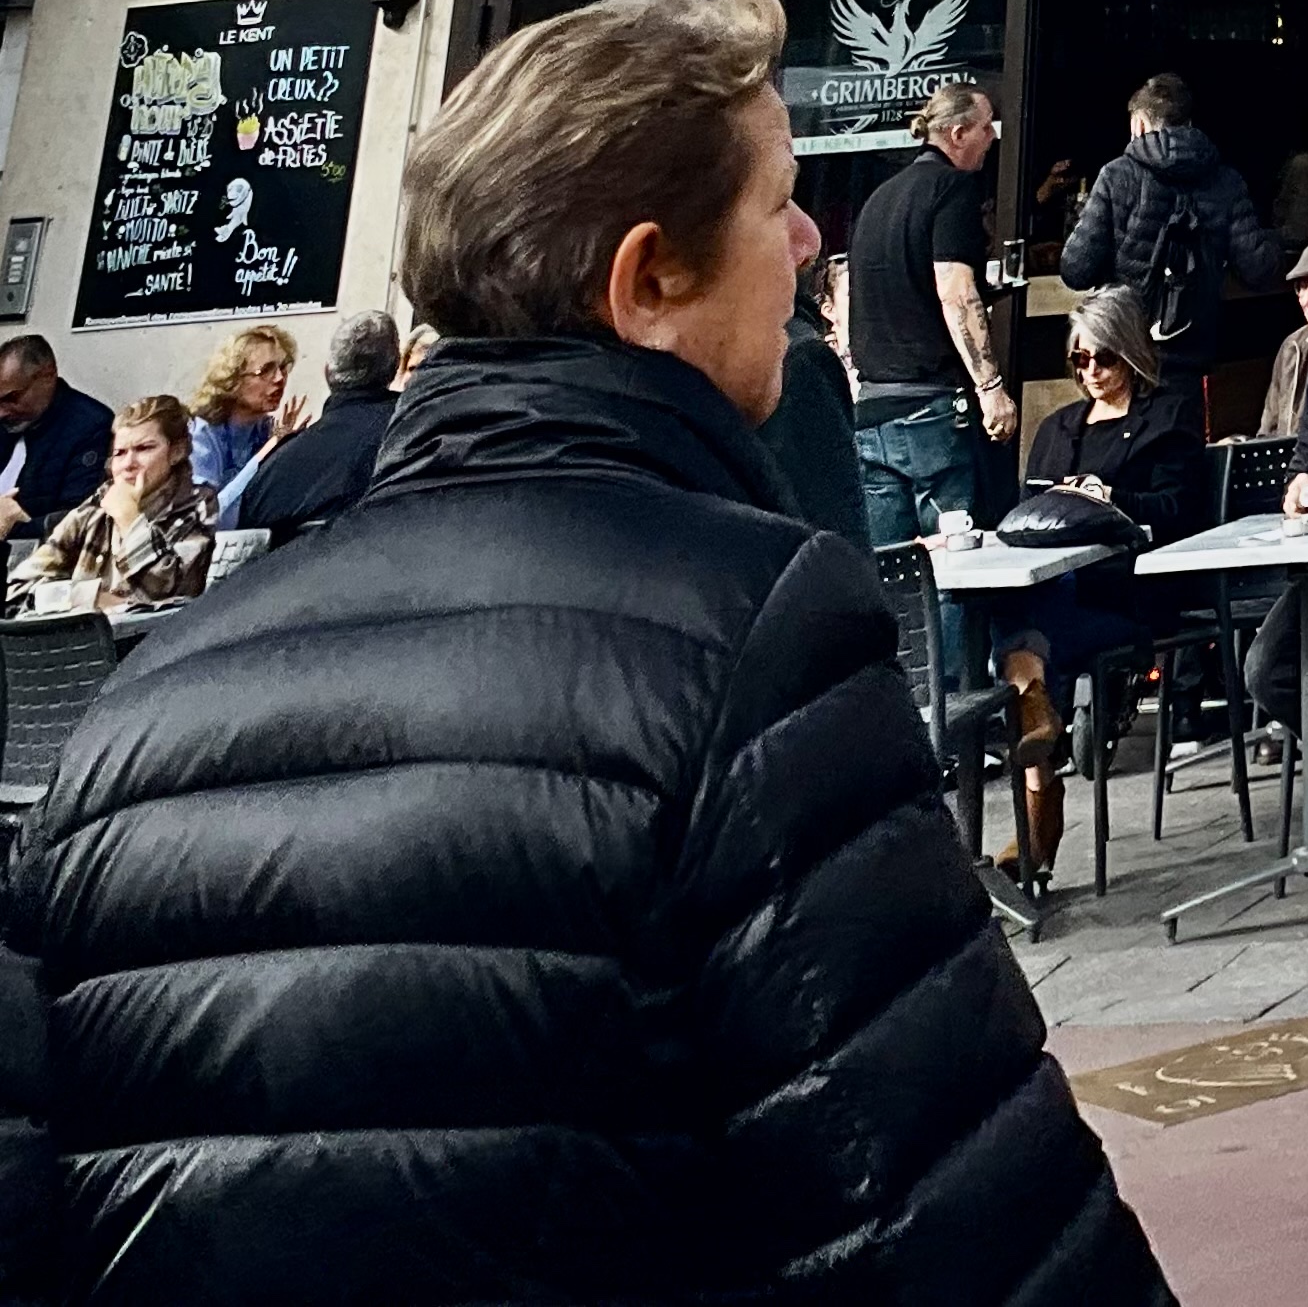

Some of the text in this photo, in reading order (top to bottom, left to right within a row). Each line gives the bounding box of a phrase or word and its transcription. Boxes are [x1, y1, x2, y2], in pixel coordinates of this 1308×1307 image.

[219, 26, 276, 45] LE KENT
[270, 48, 293, 72] UN
[881, 111, 904, 123] 1128
[258, 147, 275, 167] de
[235, 229, 281, 264] Bon
